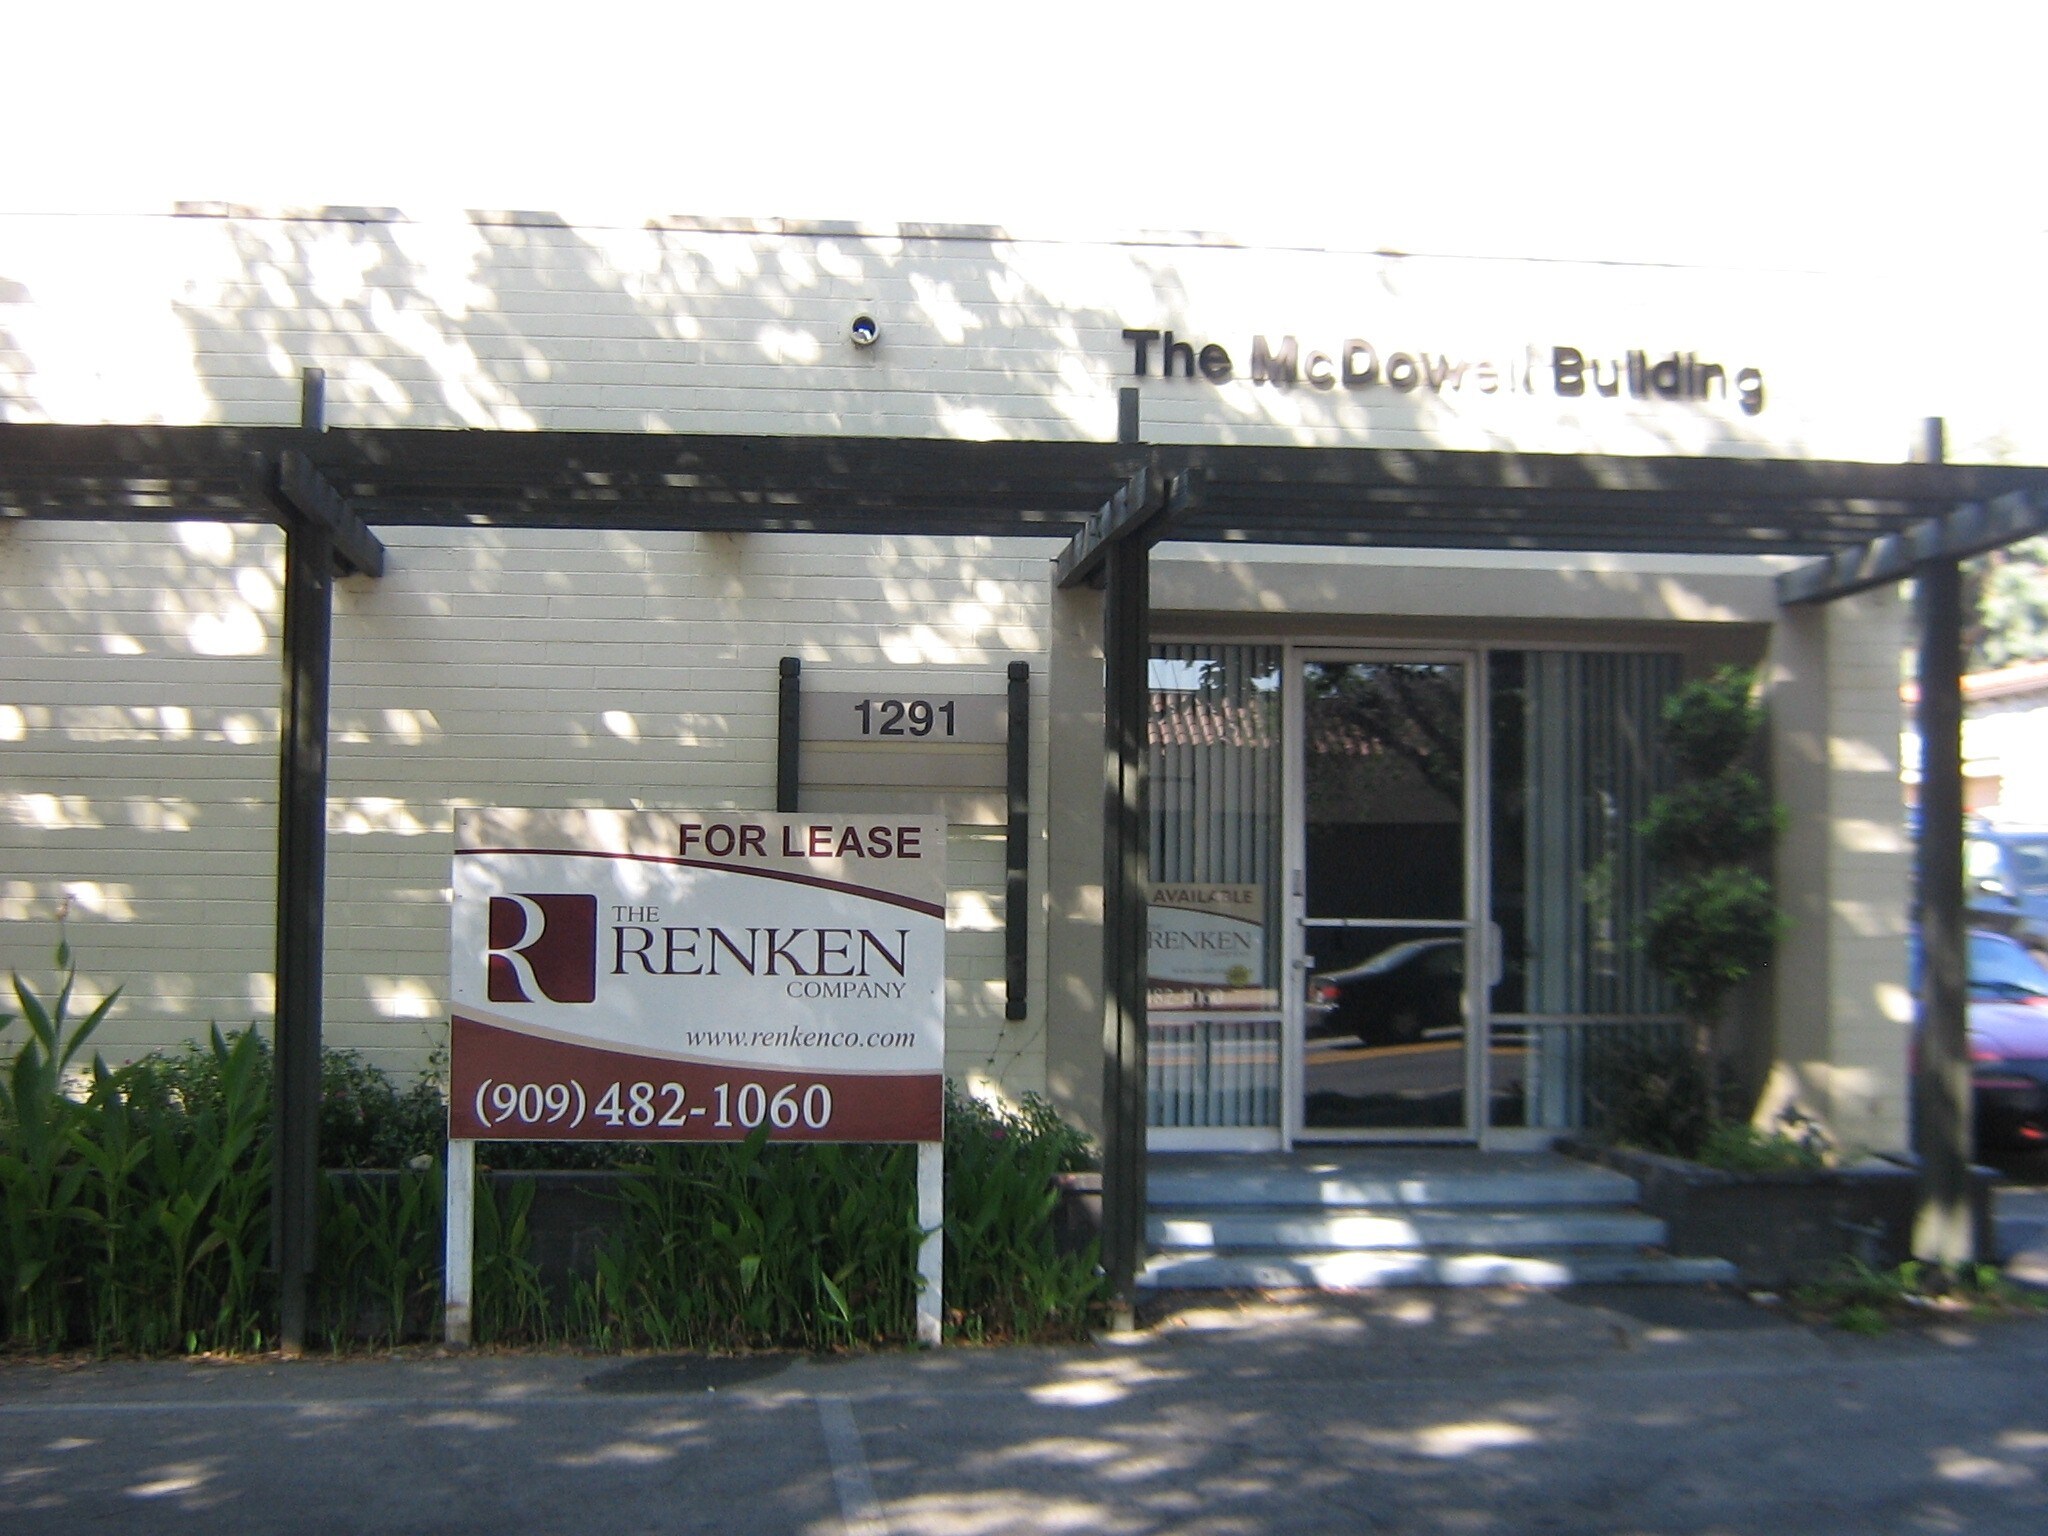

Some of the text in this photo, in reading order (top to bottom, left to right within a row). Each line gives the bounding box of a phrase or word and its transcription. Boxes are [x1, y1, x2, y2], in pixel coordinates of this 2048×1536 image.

[1122, 329, 1233, 382] The
[1552, 347, 1764, 415] Building
[854, 699, 955, 736] 1291
[679, 824, 922, 859] FOR LEASE
[612, 905, 660, 923] THE
[610, 926, 911, 977] RENKEN
[1148, 931, 1252, 950] RENKEN
[786, 981, 906, 999] COMPANY
[687, 1026, 915, 1048] www.renkenco.com
[475, 1079, 832, 1129] (909) 482-1060
